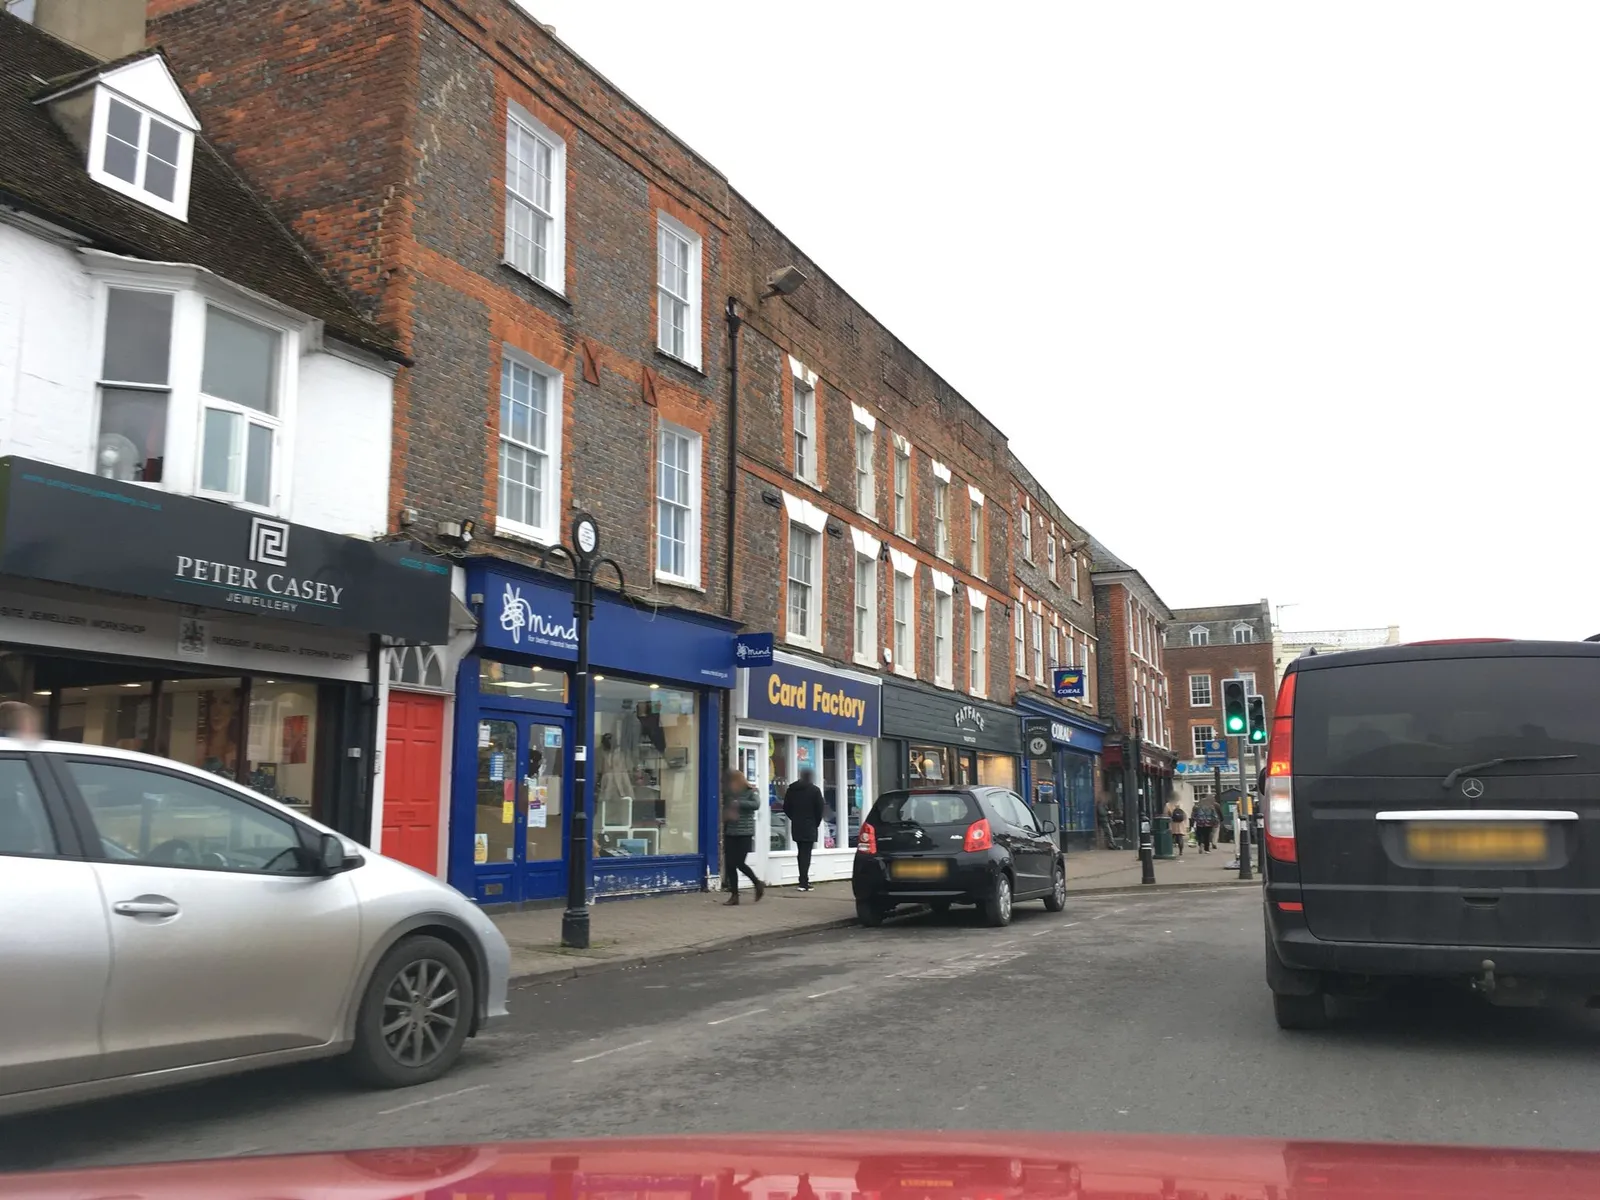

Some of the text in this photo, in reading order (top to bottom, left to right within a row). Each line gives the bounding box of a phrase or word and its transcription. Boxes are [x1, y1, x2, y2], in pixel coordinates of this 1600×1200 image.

[175, 555, 343, 605] PETER CASEY
[226, 593, 299, 612] JEWELLERY
[29, 610, 87, 626] JEWELLERY
[91, 618, 147, 634] WORKSHOP
[528, 613, 579, 641] mind
[212, 636, 250, 648] RESIDENT
[253, 642, 290, 653] JEWELLER
[747, 646, 771, 655] mind
[768, 673, 866, 726] Card Factory
[954, 705, 985, 732] FATFACE
[1051, 723, 1070, 742] CORAL
[1188, 764, 1238, 774] BARCAYS
